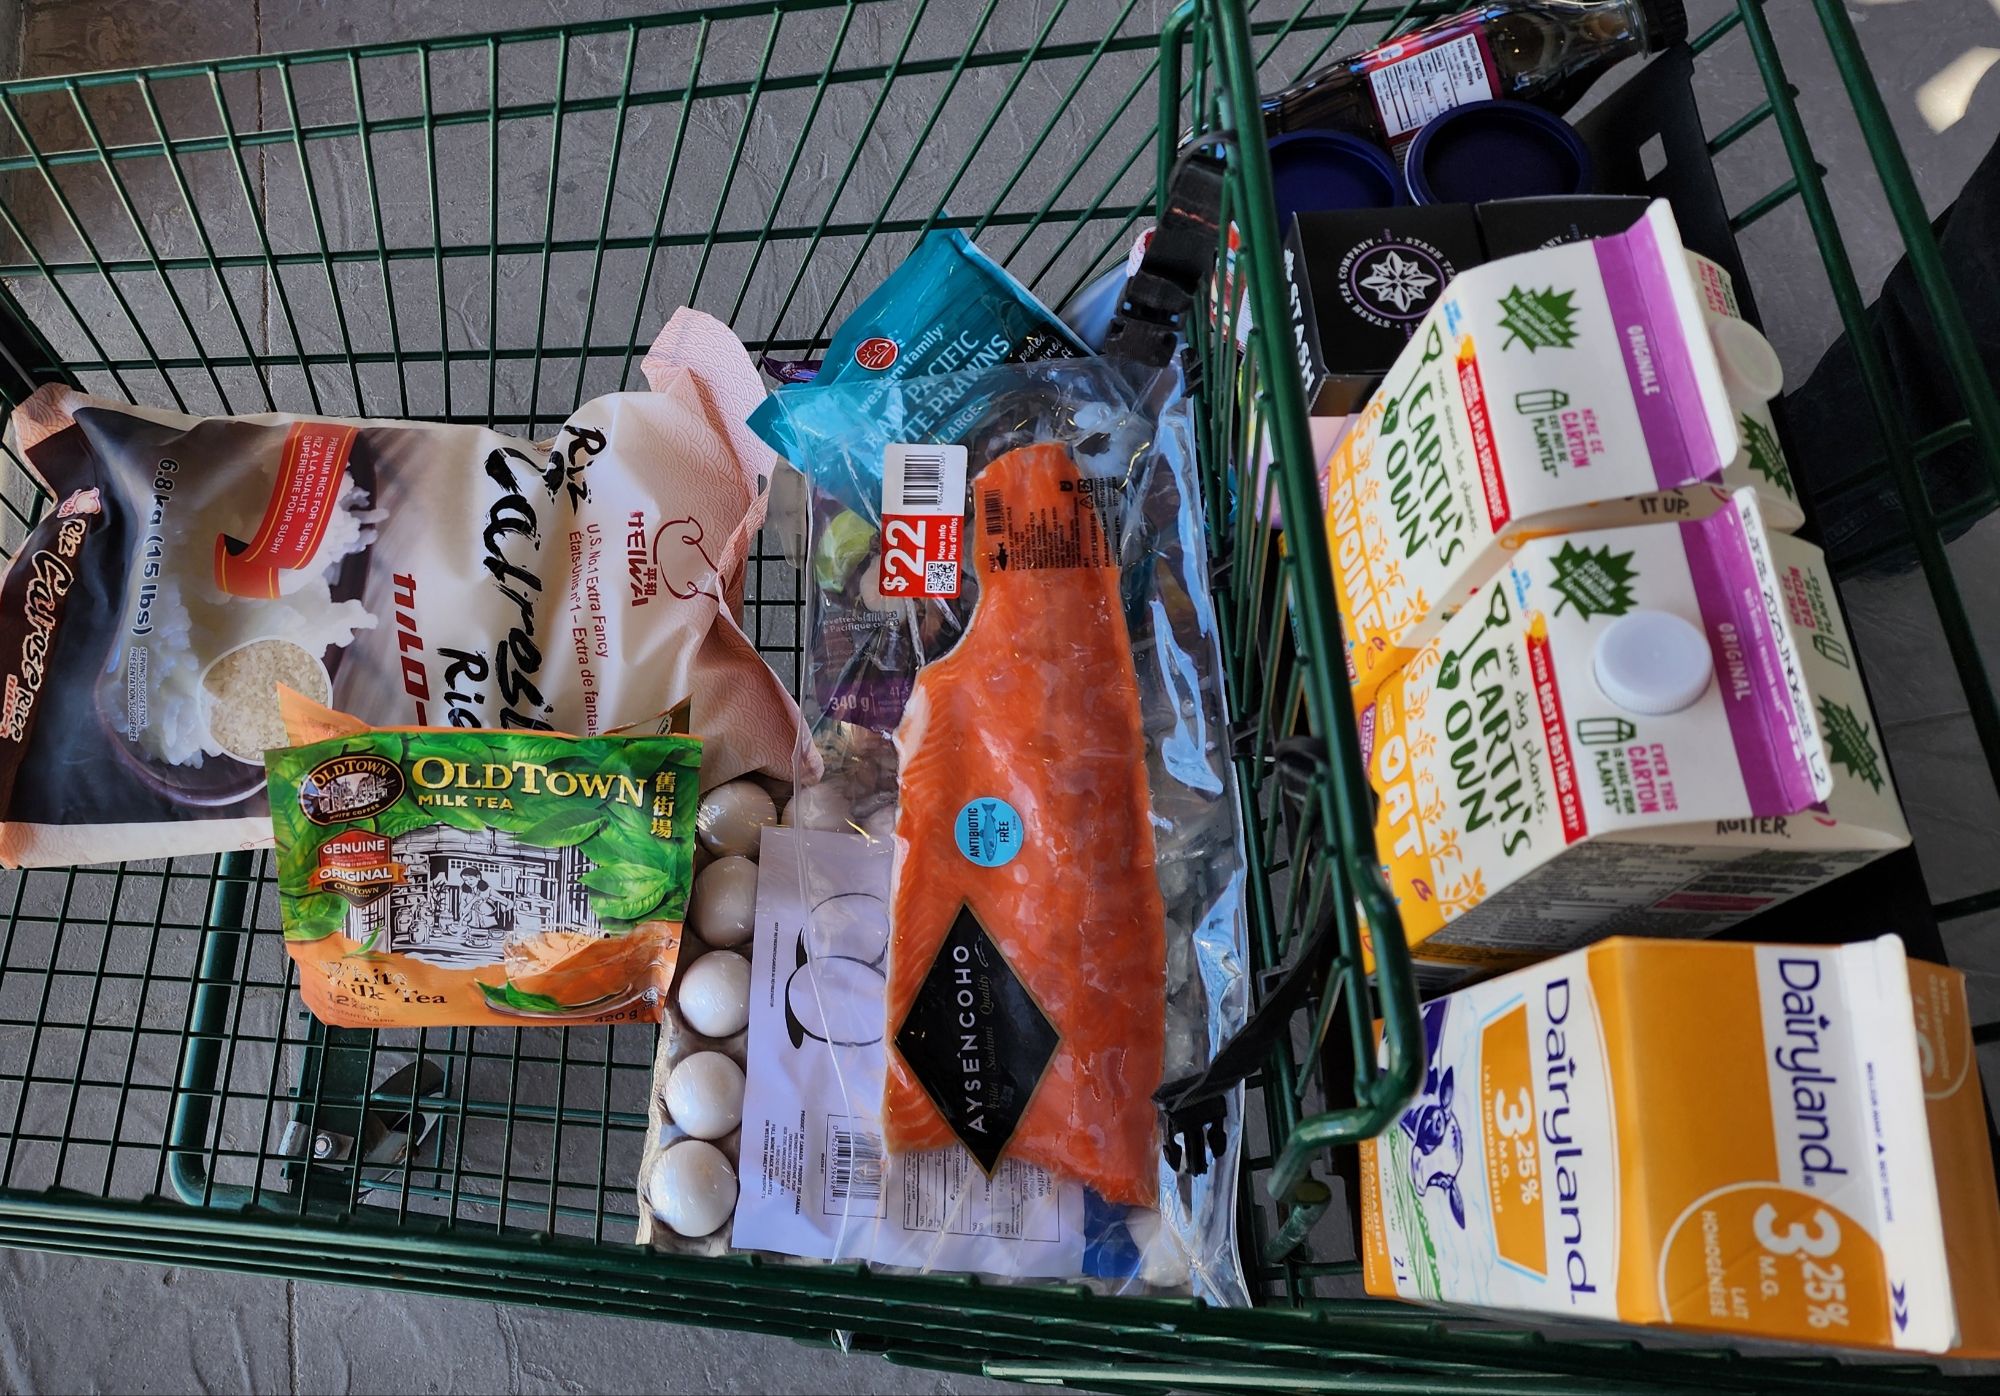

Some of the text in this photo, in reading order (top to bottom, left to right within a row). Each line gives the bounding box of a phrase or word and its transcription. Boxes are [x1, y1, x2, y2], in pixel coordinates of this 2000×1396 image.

[1338, 238, 1375, 279] COMPANY
[1405, 236, 1444, 259] STASH
[1352, 304, 1391, 328] STASH
[908, 330, 977, 403] PACIFIC
[931, 333, 1009, 415] PRAWNS
[1625, 324, 1659, 396] ORIGINALE
[312, 435, 323, 448] RIZ
[942, 404, 979, 442] LARGE
[1560, 411, 1590, 470] CARTON
[152, 457, 179, 491] 6.8
[307, 459, 317, 471] LA
[563, 425, 607, 514] Riz
[1407, 383, 1464, 567] EARTH'S
[270, 435, 312, 553] SUPÉRIEURE POUR SUSHI
[295, 436, 338, 551] PREMIUM RICE FOR SUSHI
[296, 473, 313, 514] QUALITÉ
[1387, 440, 1432, 559] OWN
[586, 523, 601, 549] U.S.
[937, 524, 946, 559] More Info
[948, 517, 958, 542] d'infos
[141, 534, 163, 579] (15
[564, 531, 589, 589] États-Unis
[624, 512, 650, 605] HEIWA
[882, 520, 927, 592] $22
[1332, 486, 1383, 644] AVOINE
[585, 576, 601, 611] Extra
[642, 567, 658, 595] 平和
[132, 583, 158, 637] lbs)
[572, 627, 589, 664] Extra
[591, 615, 609, 658] Fancy
[126, 647, 139, 699] PRÉSENTATION
[580, 669, 595, 686] de
[1718, 622, 1753, 703] ORIGINAL
[134, 648, 149, 725] SERVING SUGGESTION
[830, 693, 870, 712] 340 g
[12, 687, 34, 743] Rice
[1512, 689, 1530, 730] dig
[311, 757, 391, 789] OLDTOWN
[1443, 699, 1496, 835] OWN
[1470, 647, 1532, 858] EARTH'S
[411, 756, 648, 809] OLDTOWN
[1377, 735, 1422, 861] OAT
[1629, 746, 1661, 813] CARTON
[418, 794, 514, 811] MILK TEA
[322, 839, 386, 855] GENUINE
[967, 807, 979, 857] ANTIBIOTIC
[999, 820, 1009, 842] FREE
[318, 864, 393, 882] ORIGINAL
[334, 881, 381, 897] OLDTOWN
[978, 974, 993, 1014] Quality
[1776, 957, 1848, 1175] Dairyland
[1543, 977, 1597, 1297] Dairyland
[1393, 1255, 1406, 1285] 2 L
